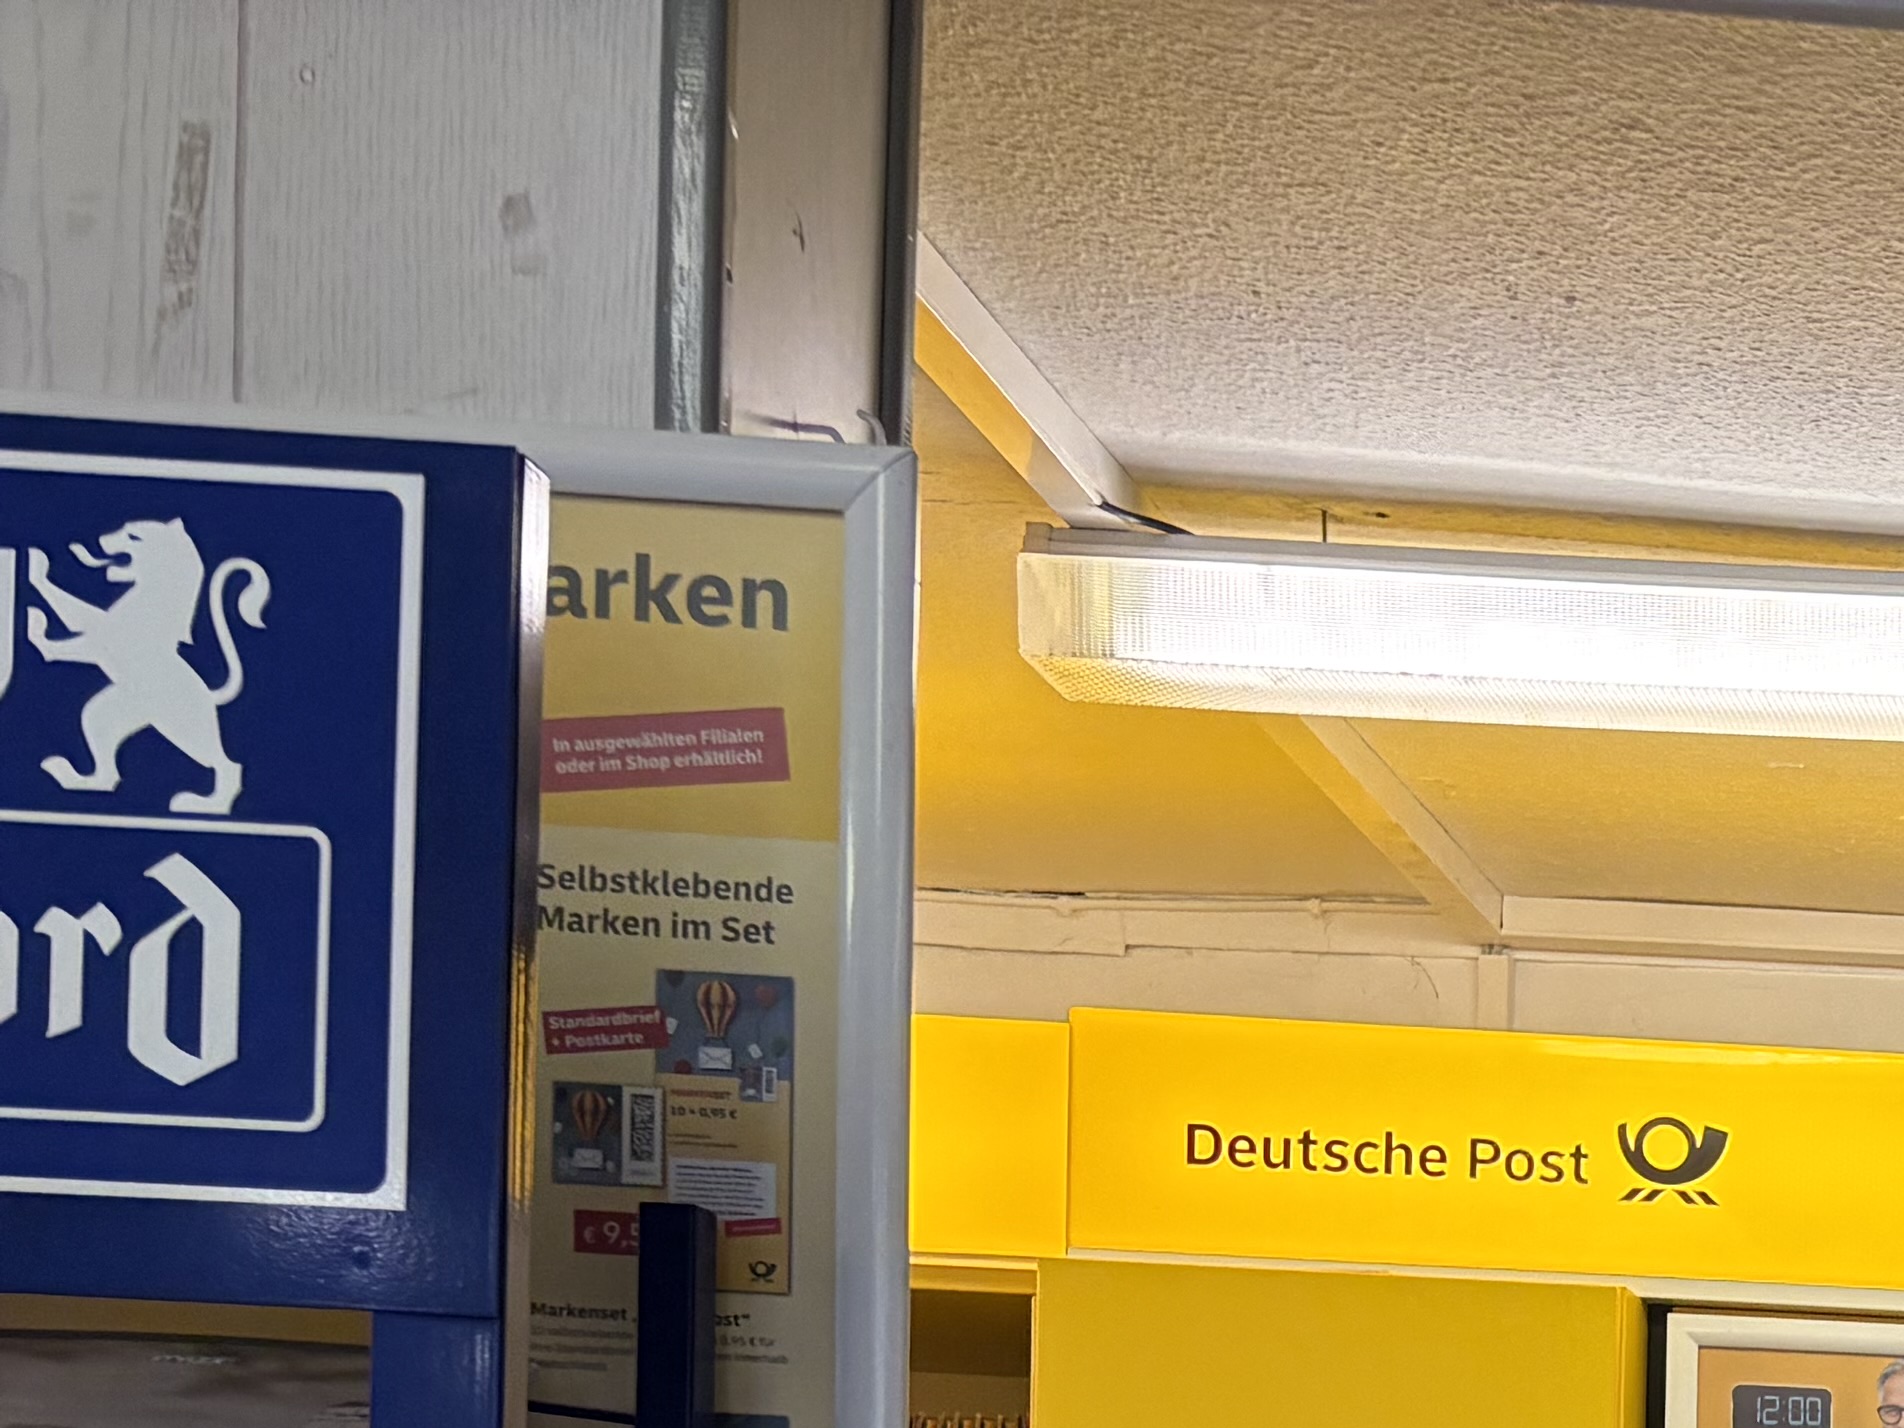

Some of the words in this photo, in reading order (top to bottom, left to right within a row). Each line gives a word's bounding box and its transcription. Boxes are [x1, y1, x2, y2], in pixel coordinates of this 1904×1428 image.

[552, 736, 571, 753] In
[576, 729, 695, 754] ausgewählten
[700, 726, 765, 747] Filialen
[555, 754, 595, 775] oder
[600, 753, 619, 771] im
[623, 749, 671, 774] Shop
[675, 746, 764, 769] erhältlich!
[537, 864, 794, 904] Selbstklebende
[537, 905, 660, 938] Marken
[672, 912, 711, 940] im
[722, 916, 776, 945] Set
[1184, 1122, 1449, 1178] Deutsche
[1465, 1137, 1588, 1189] Post
[1754, 1395, 1823, 1428] 12:00
